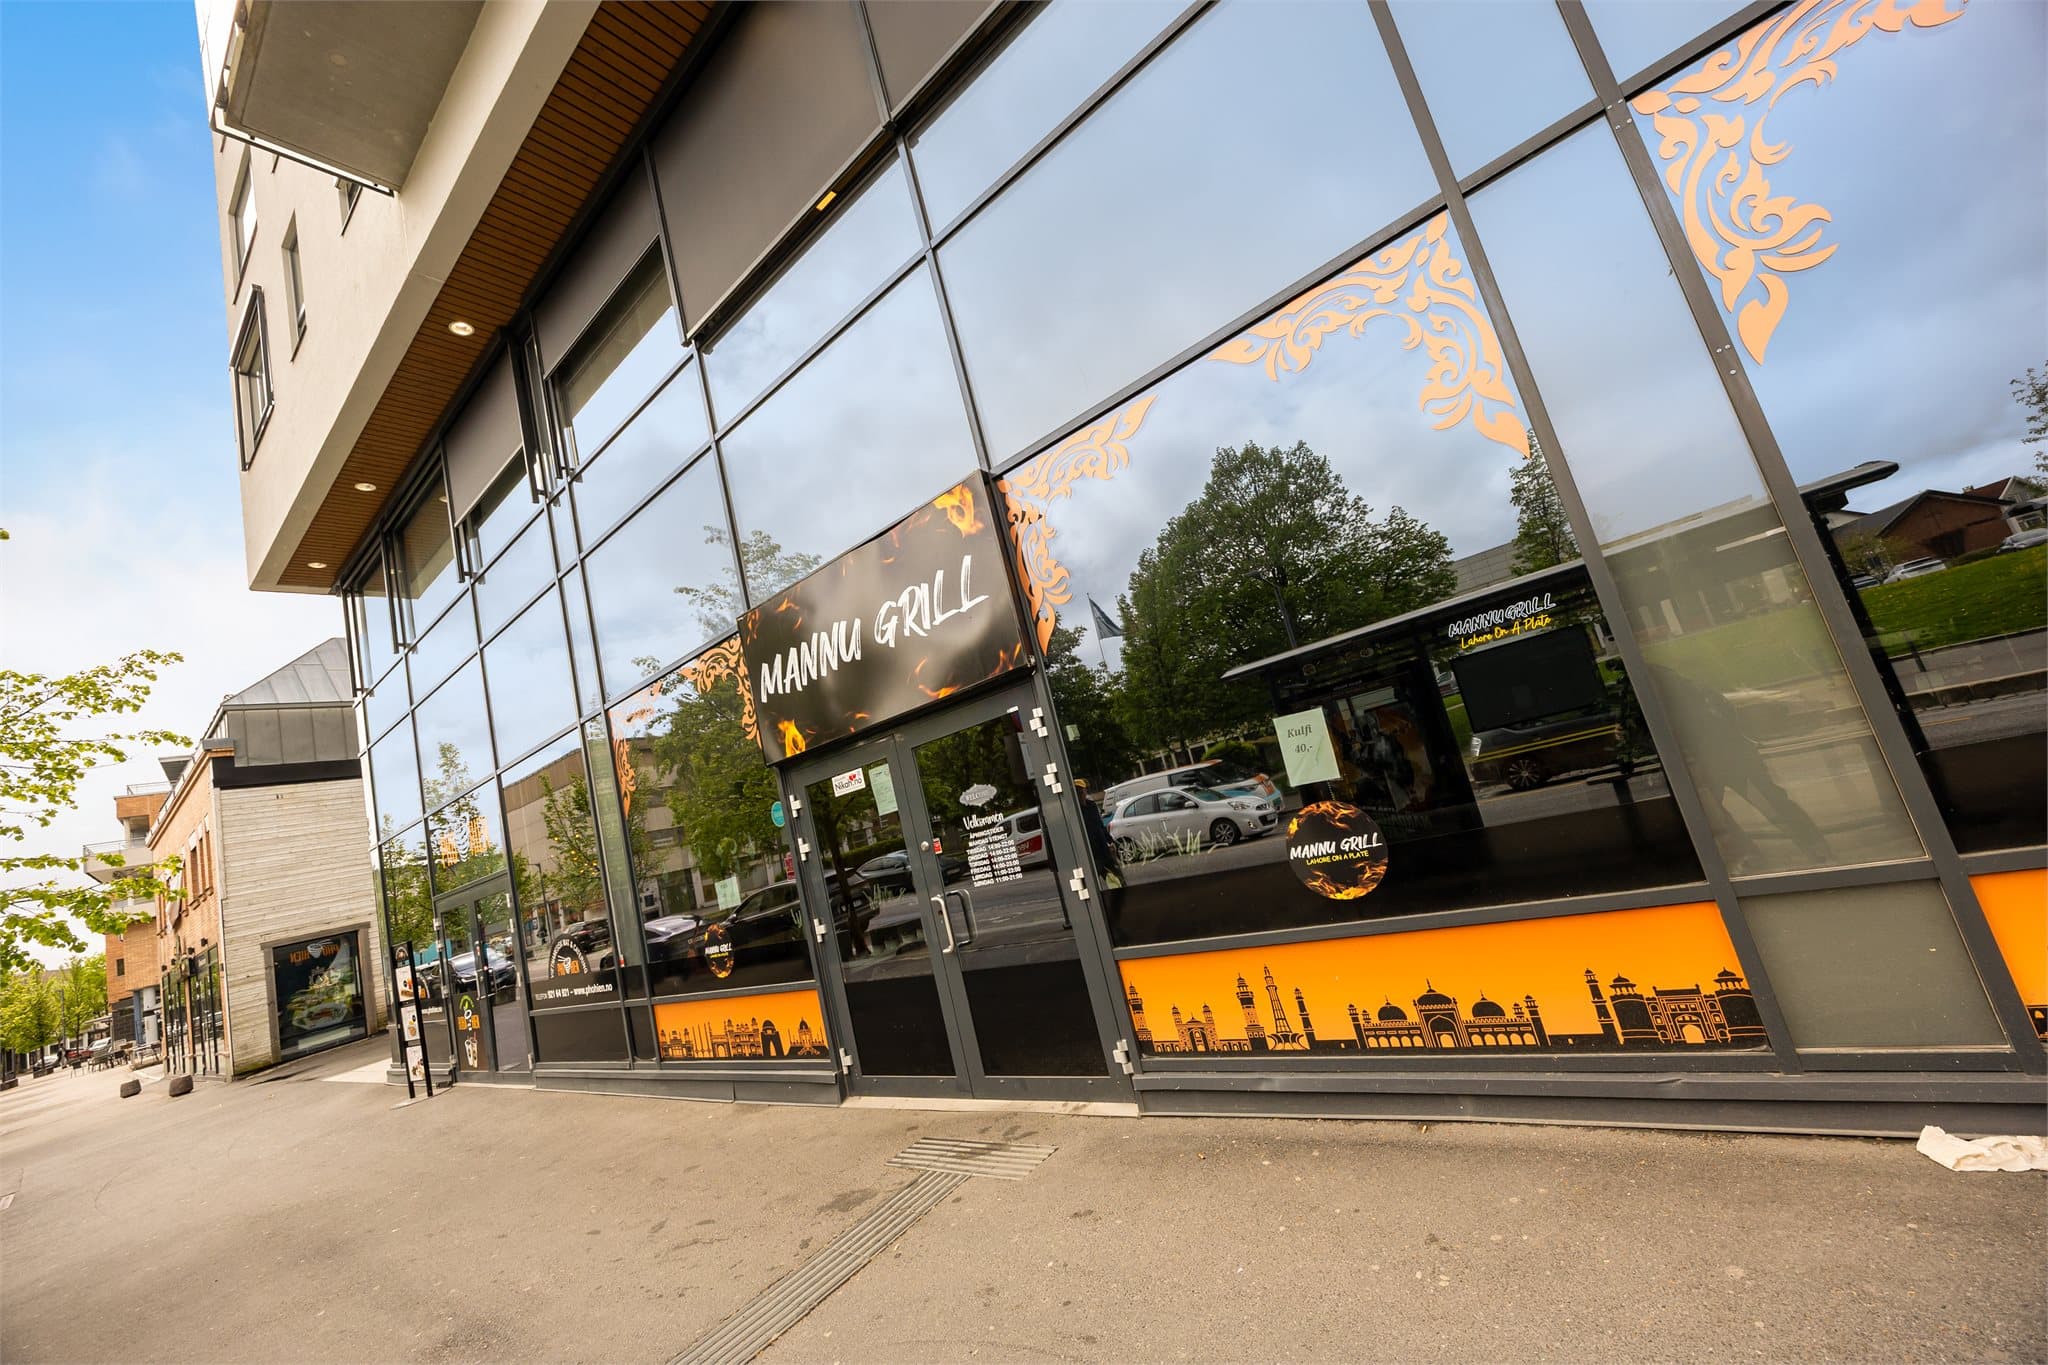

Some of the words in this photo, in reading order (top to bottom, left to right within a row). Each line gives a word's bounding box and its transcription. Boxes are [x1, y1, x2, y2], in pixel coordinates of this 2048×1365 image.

[761, 617, 862, 703] MANNU
[874, 555, 990, 648] GRILL
[1448, 608, 1504, 638] MANNU
[1505, 592, 1557, 620] GRILL
[1461, 633, 1493, 649] Lahore
[1494, 626, 1509, 638] On
[1510, 620, 1521, 636] A
[1523, 613, 1553, 631] Plate
[1287, 723, 1313, 739] Kulfi
[1289, 841, 1336, 860] MANNU
[1340, 832, 1383, 852] GRILL
[1306, 857, 1331, 866] LAHORE
[1349, 850, 1369, 859] PLATE
